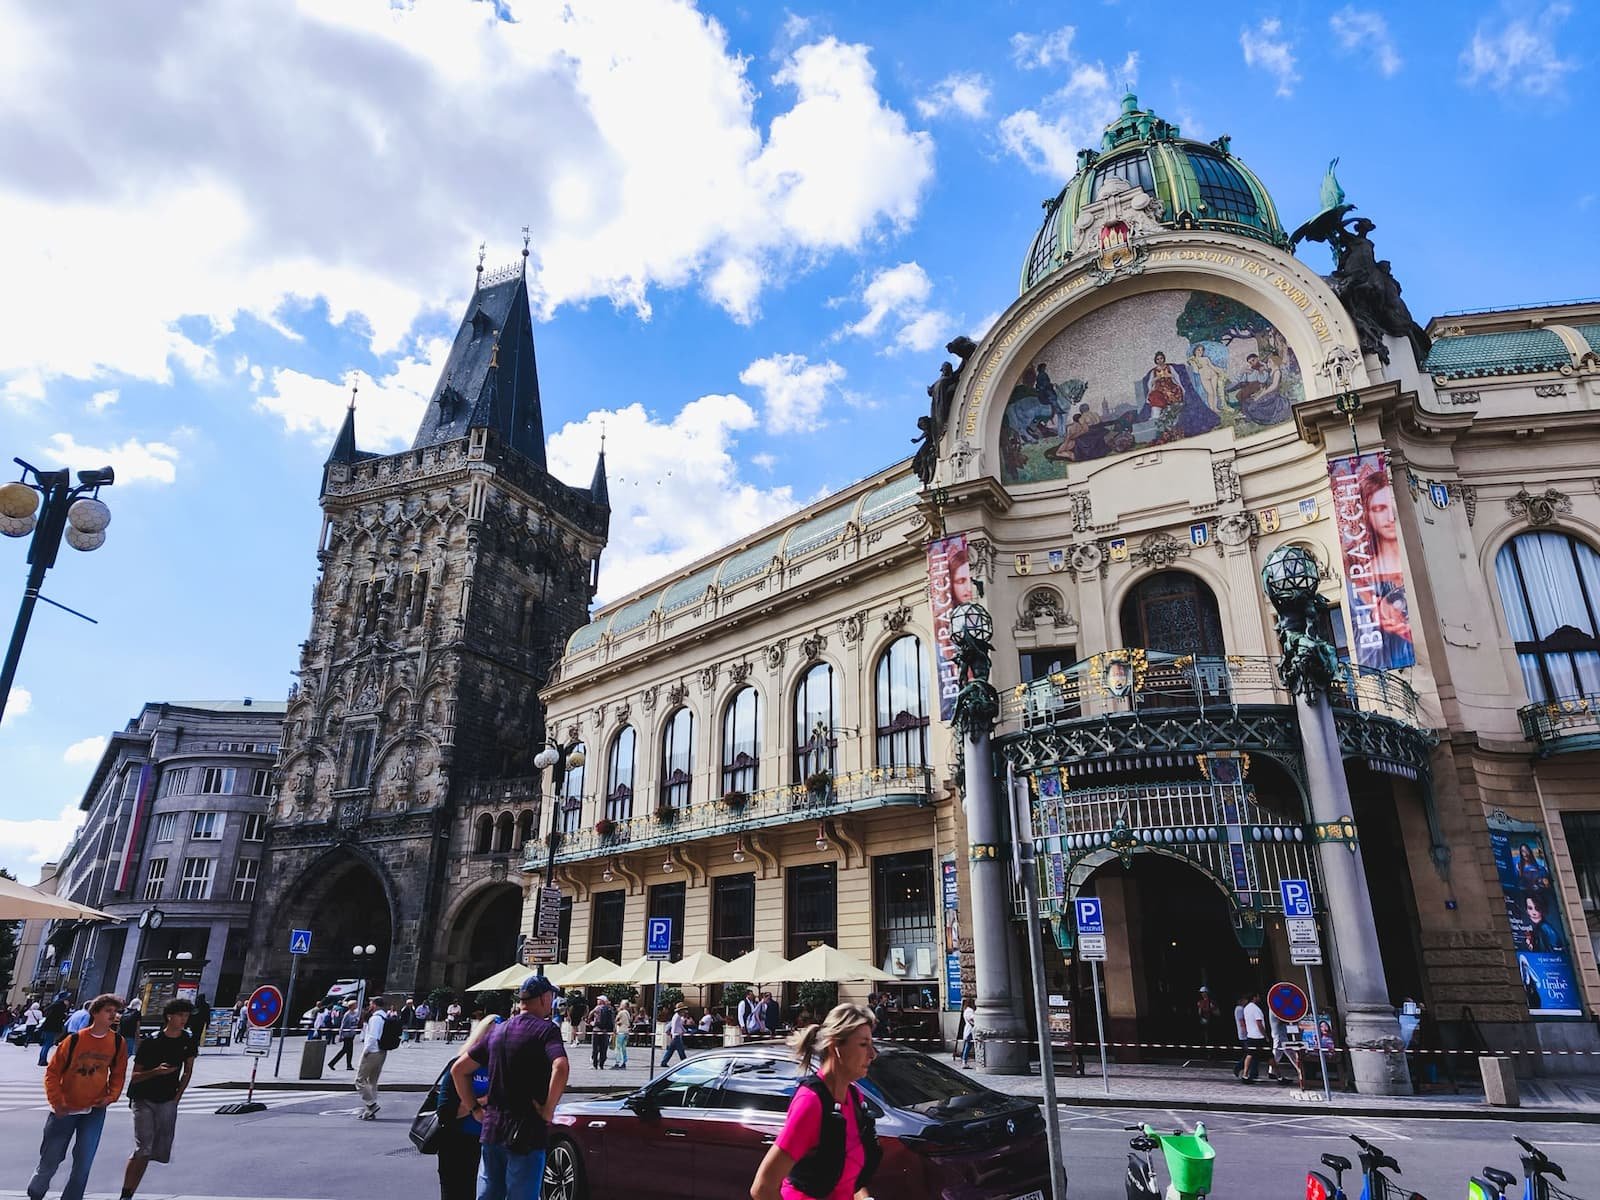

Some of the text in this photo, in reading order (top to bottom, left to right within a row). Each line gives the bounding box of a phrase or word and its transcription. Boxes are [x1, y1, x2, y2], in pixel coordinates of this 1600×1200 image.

[1335, 473, 1384, 649] BELTRACCHI
[932, 552, 960, 699] BELTRACCHI
[1286, 884, 1303, 906] P
[1081, 902, 1096, 924] P
[653, 922, 666, 943] P
